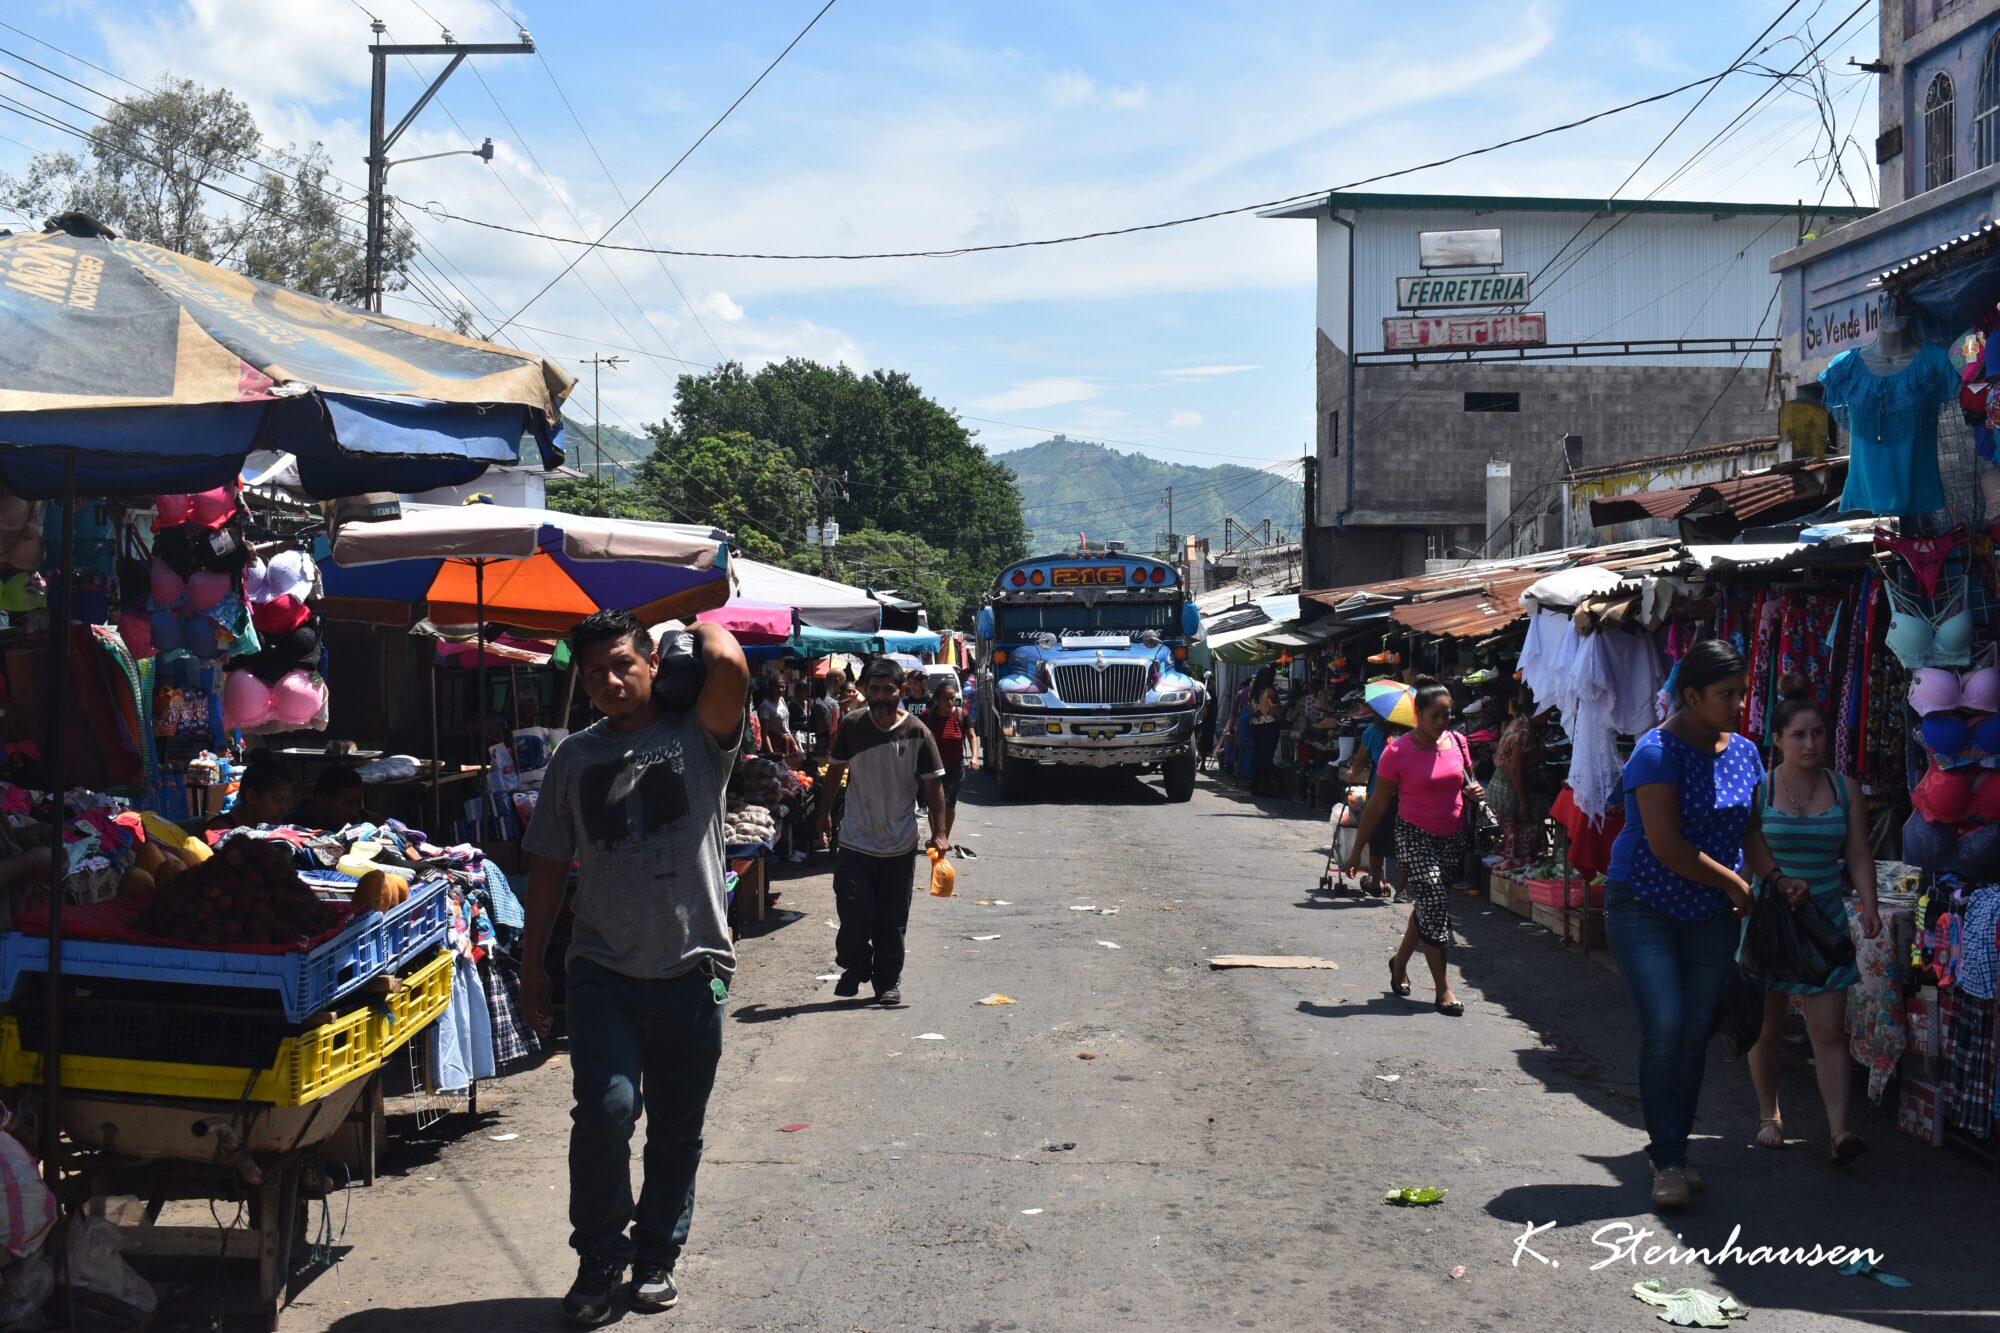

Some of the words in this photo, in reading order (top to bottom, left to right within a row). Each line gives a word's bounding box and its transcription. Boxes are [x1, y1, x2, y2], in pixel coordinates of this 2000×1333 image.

[1407, 277, 1525, 304] FERRETERIA
[1806, 316, 1823, 350] Se
[1824, 308, 1861, 345] Vende
[1053, 567, 1124, 586] 216
[1058, 627, 1084, 638] los
[1094, 627, 1163, 639] naranjs
